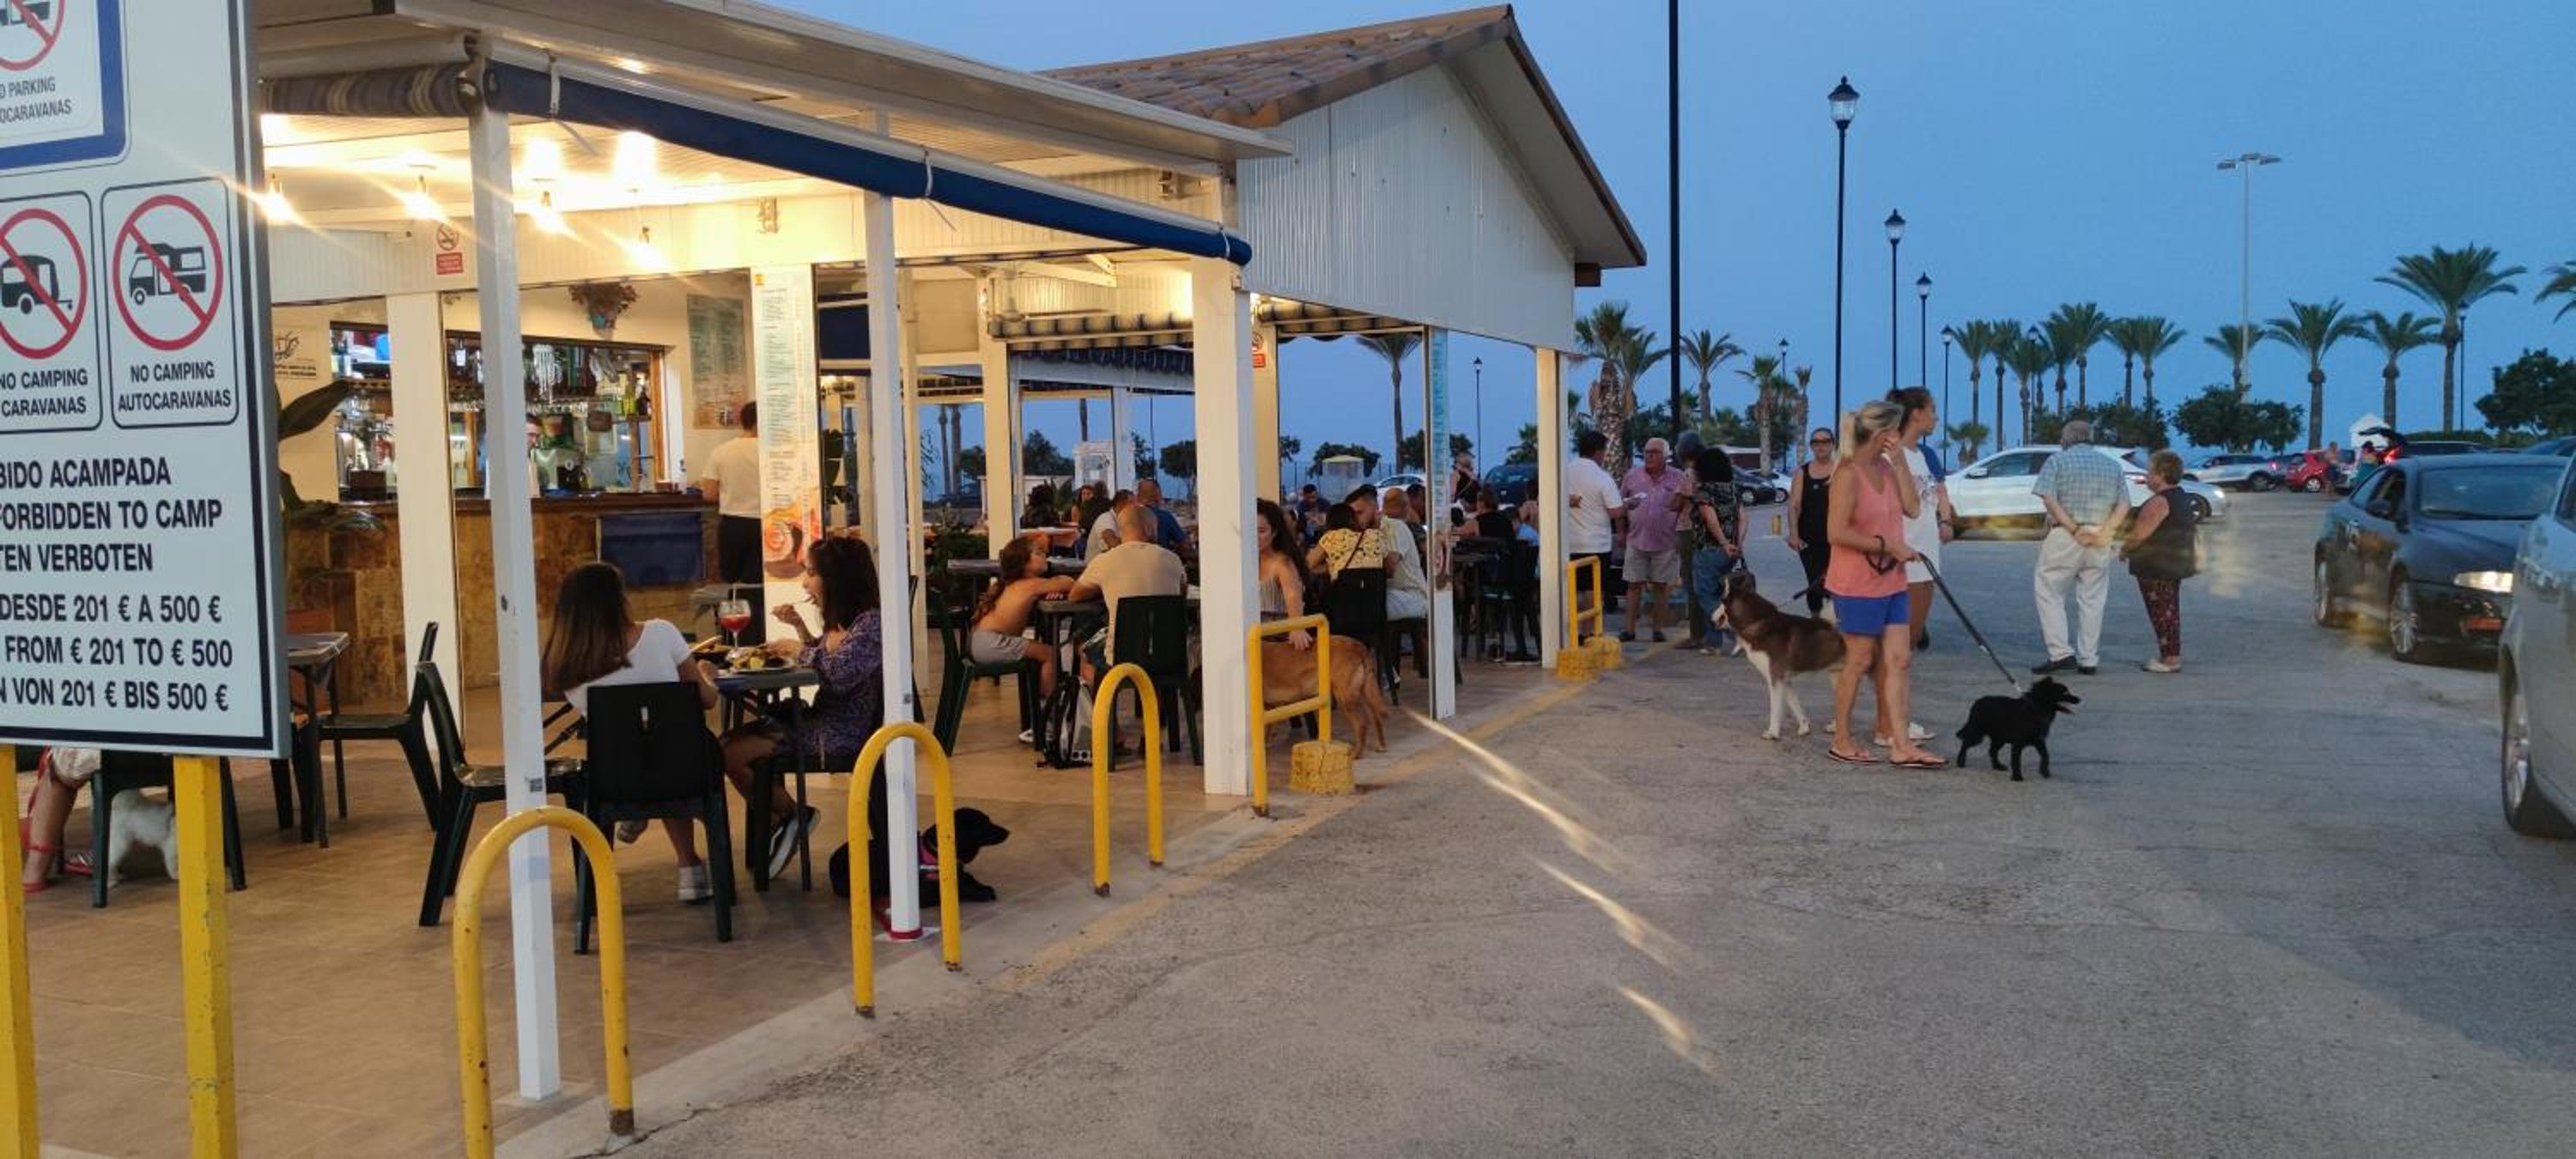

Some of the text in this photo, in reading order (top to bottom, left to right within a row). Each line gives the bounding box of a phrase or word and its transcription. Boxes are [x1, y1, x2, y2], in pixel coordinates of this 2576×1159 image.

[8, 76, 56, 98] PARKING
[21, 367, 88, 389] CAMPING
[131, 361, 215, 383] NO CAMPING
[1, 396, 87, 417] CARAVANAS
[118, 388, 232, 412] AUTOCARAVANAS
[50, 457, 172, 488] ACAMPADA
[0, 499, 222, 530] ORBIDDEN TO CAMP
[38, 543, 153, 572] VERBOTEN
[0, 593, 222, 623] DESDE 201 € A 500 €
[5, 635, 233, 667] FROM € 201 TO € 500
[12, 677, 54, 705] VON
[61, 680, 95, 707] 201
[105, 681, 118, 708] €
[125, 681, 160, 709] BIS
[167, 683, 207, 711] 500
[214, 684, 229, 712] €
